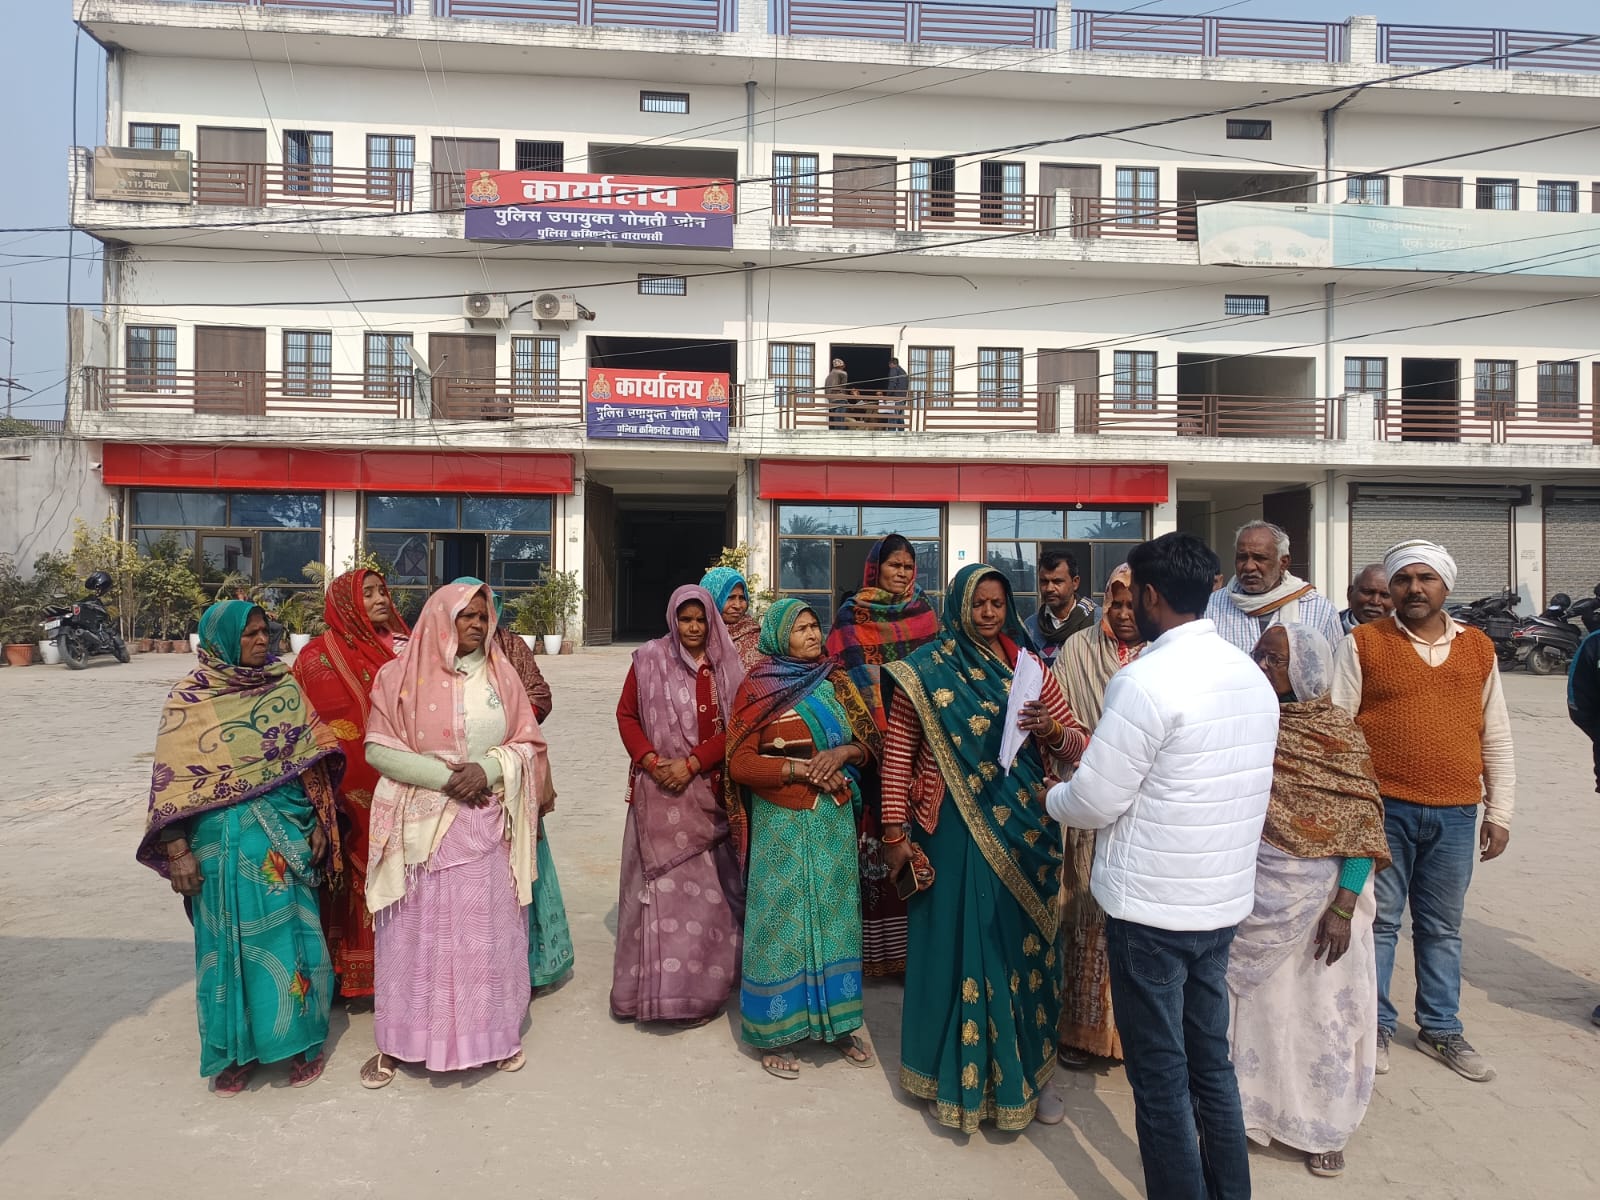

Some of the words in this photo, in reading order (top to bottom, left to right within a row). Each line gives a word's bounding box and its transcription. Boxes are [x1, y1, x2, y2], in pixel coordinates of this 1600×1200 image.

[128, 181, 143, 189] 112
[521, 176, 677, 207] कार्यालय
[494, 206, 542, 226] पुलिस
[546, 211, 614, 228] उपायुक्त
[619, 211, 667, 227] गोमती
[672, 213, 706, 228] जोन
[538, 227, 569, 239] पुलिस
[621, 231, 664, 241] वाराणसी
[615, 373, 703, 400] कार्यालय
[596, 404, 624, 420] पुलिस
[670, 406, 698, 420] गोमती
[701, 408, 721, 421] जोन
[617, 424, 637, 436] पुलिस
[672, 426, 700, 437] वाराणसी
